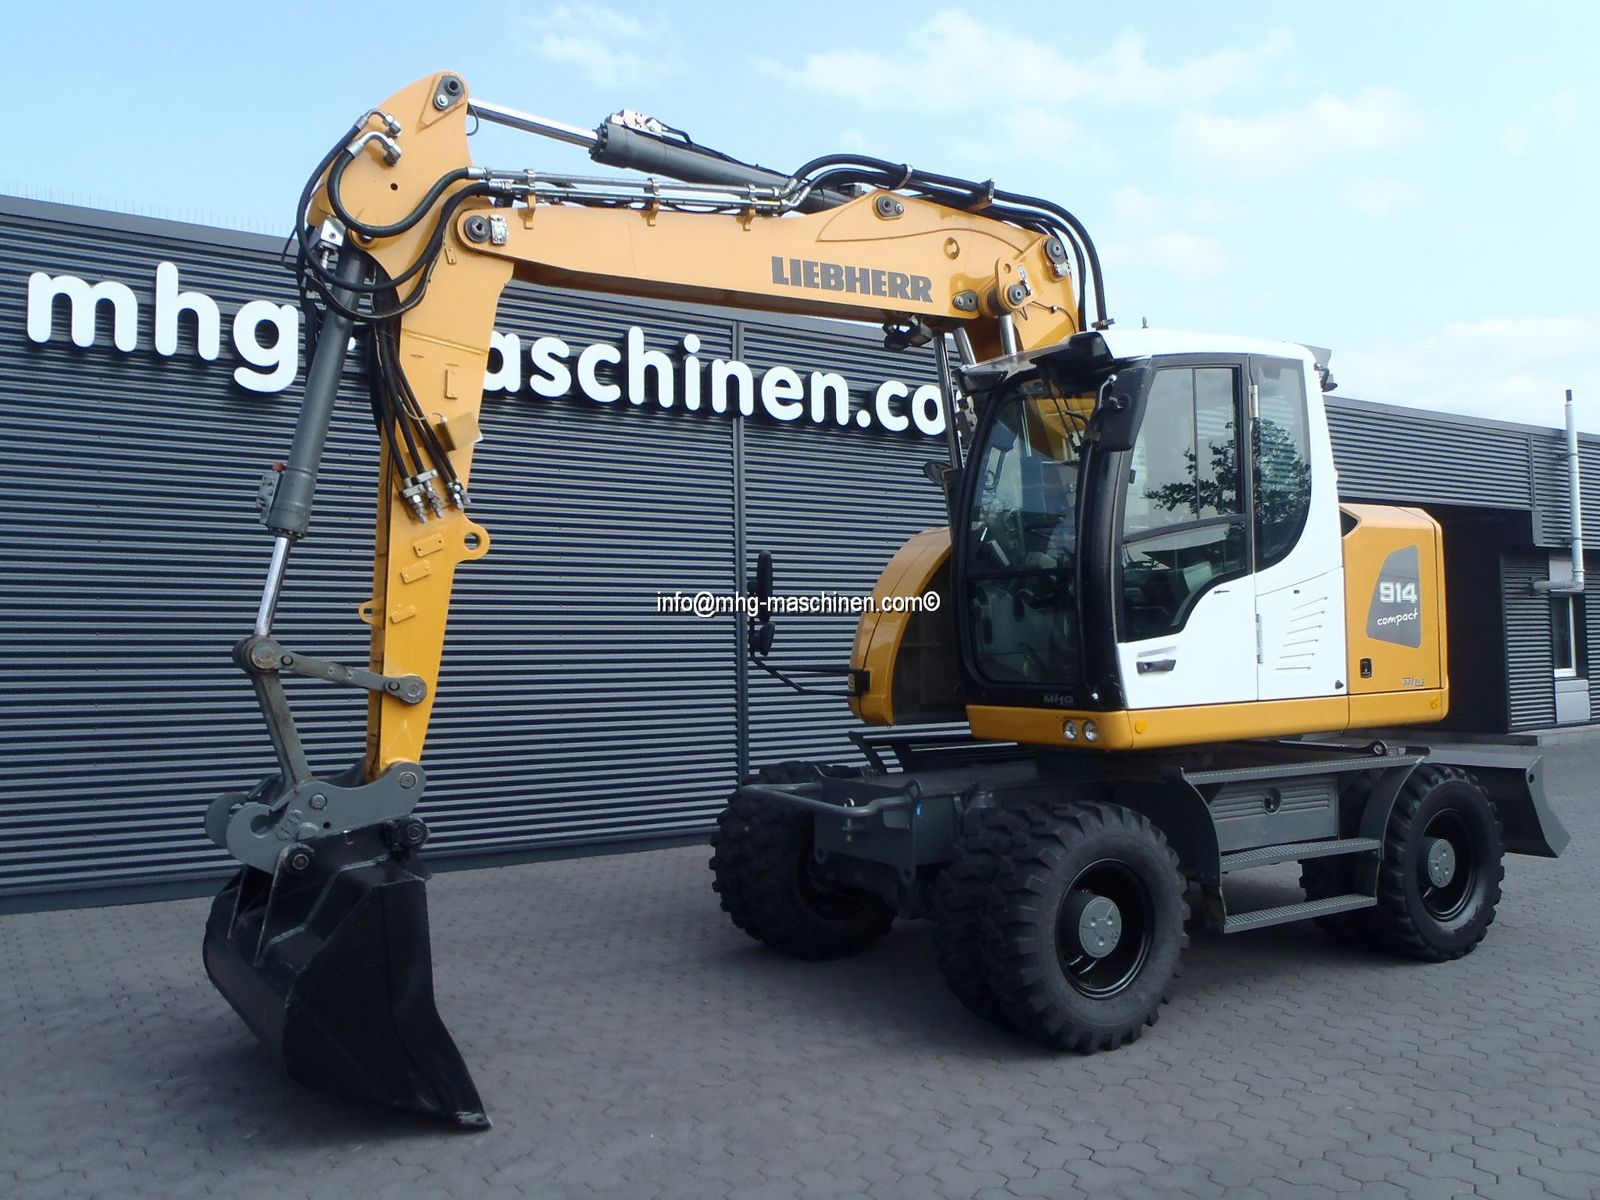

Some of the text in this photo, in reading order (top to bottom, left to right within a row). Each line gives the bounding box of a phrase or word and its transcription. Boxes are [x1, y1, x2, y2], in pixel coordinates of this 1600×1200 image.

[771, 256, 933, 302] LIEBHERR
[1380, 582, 1418, 604] 914
[1377, 608, 1419, 626] compact
